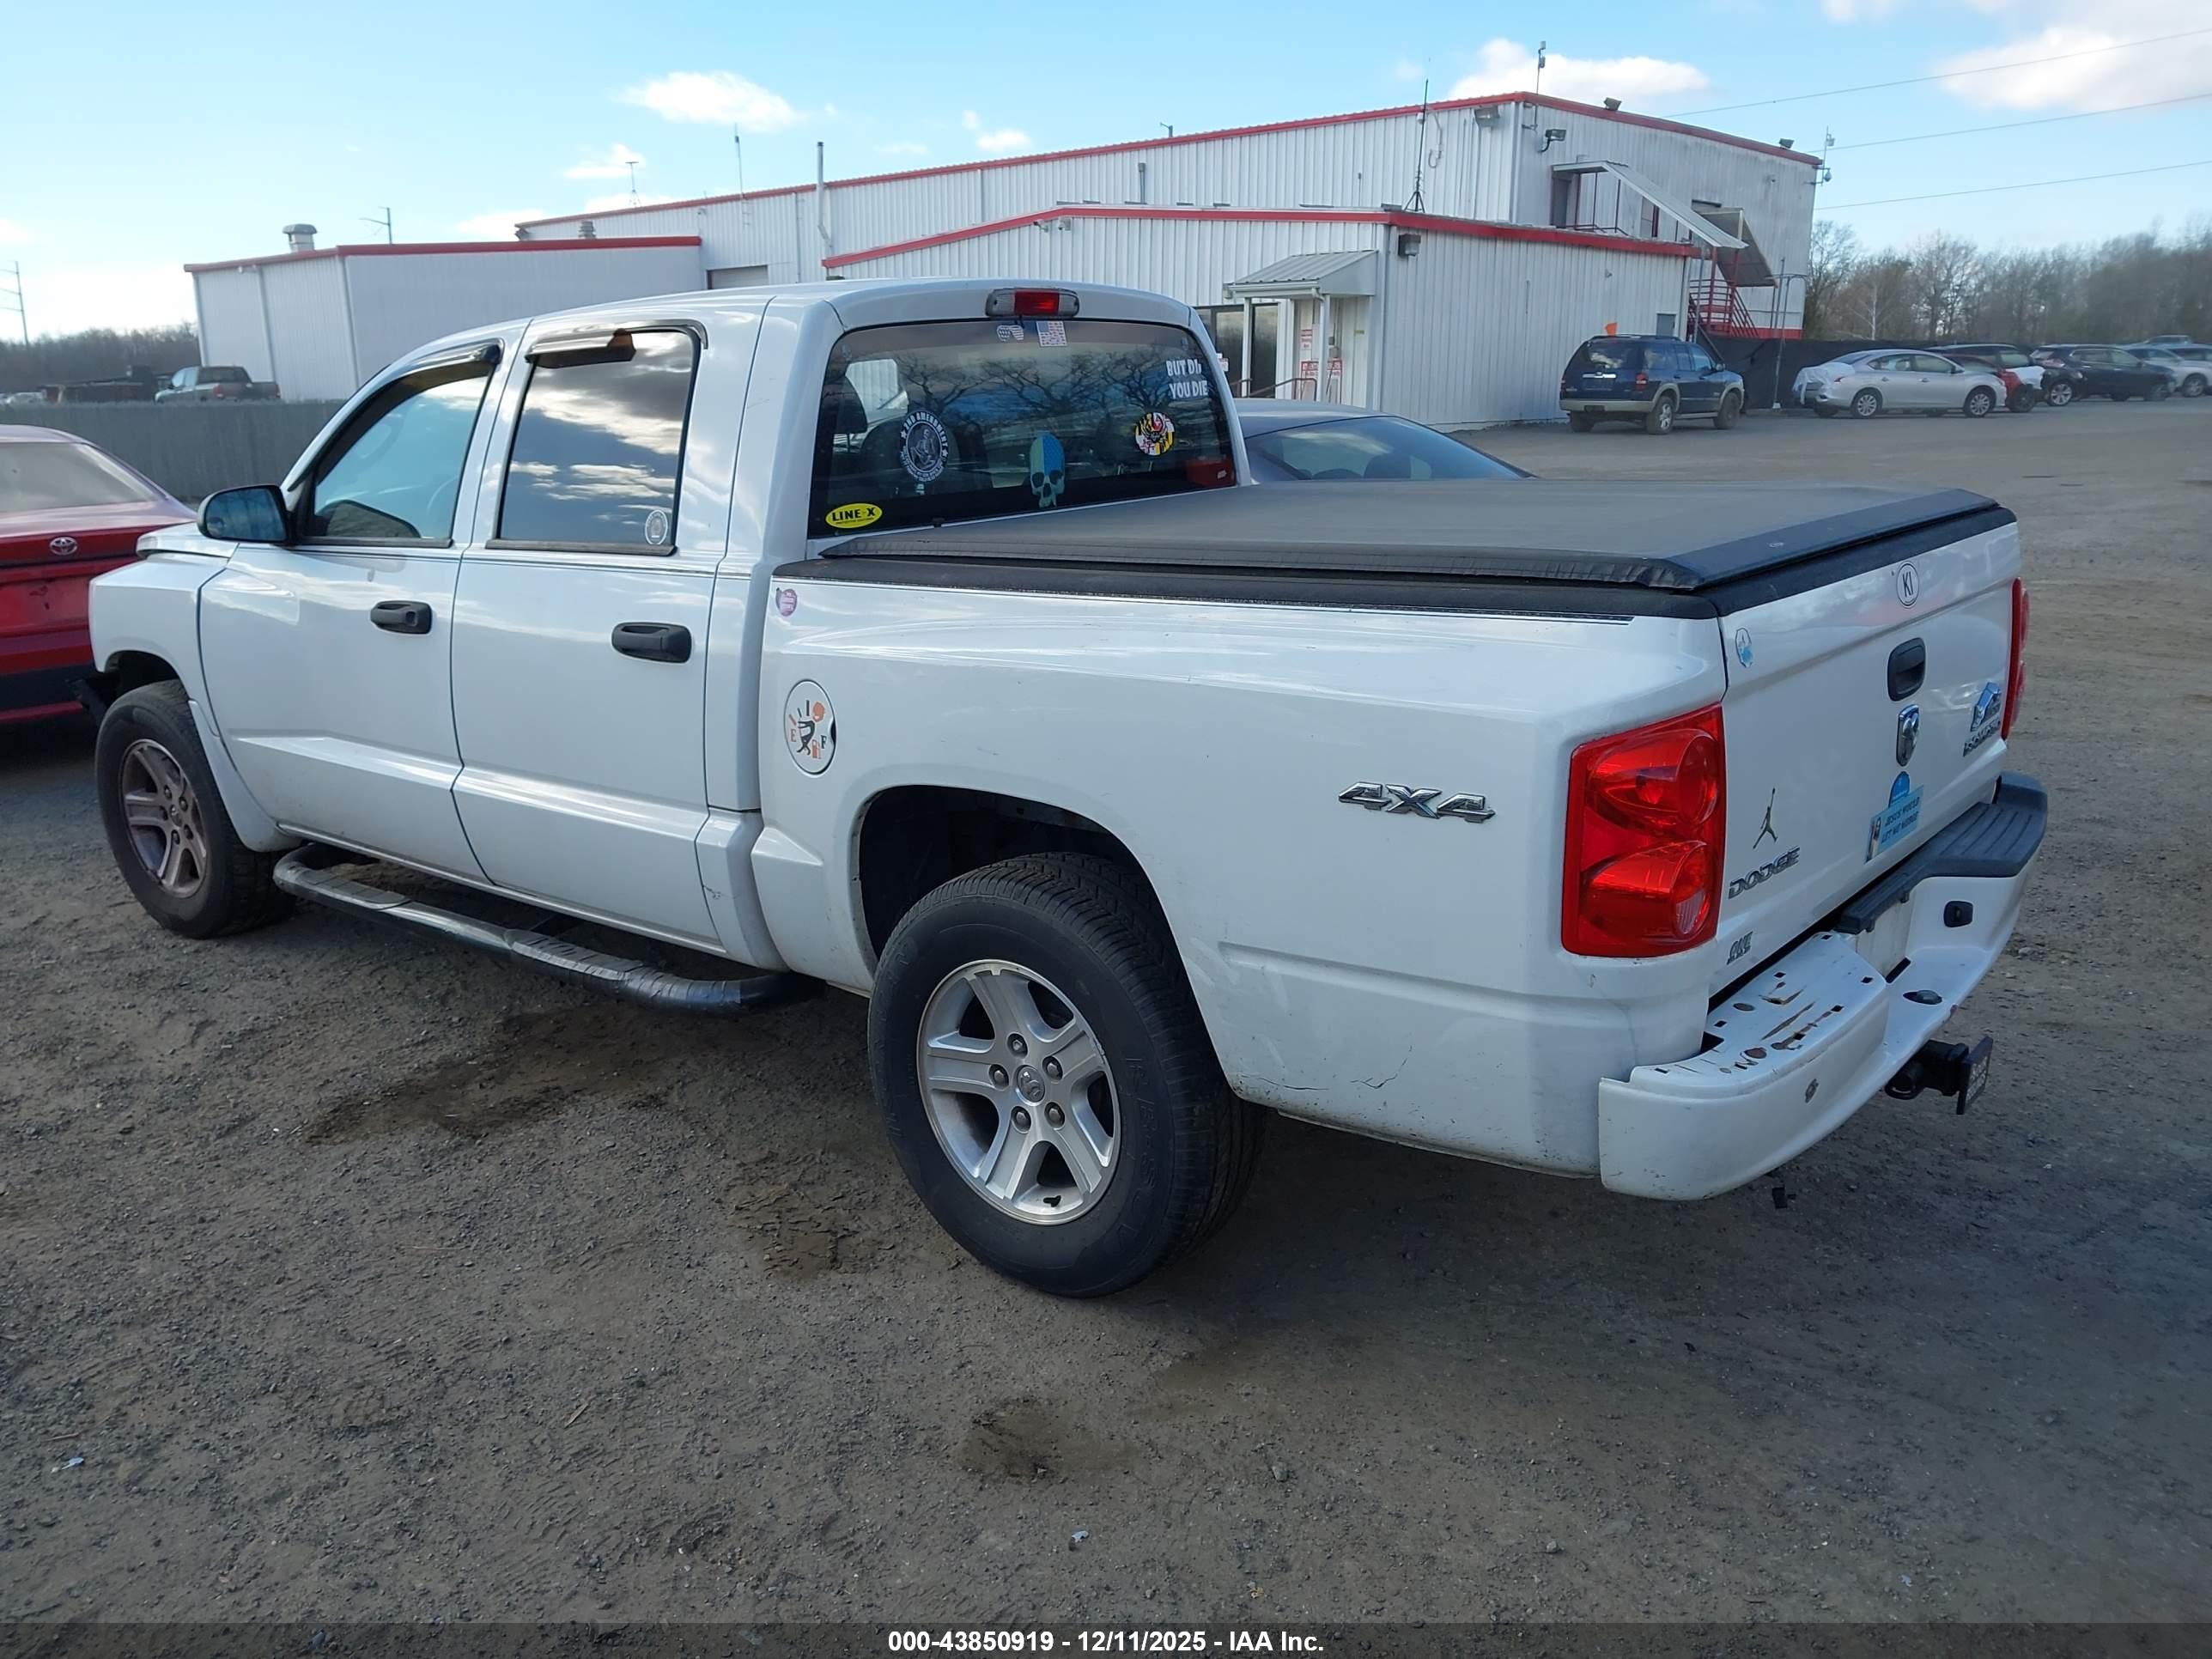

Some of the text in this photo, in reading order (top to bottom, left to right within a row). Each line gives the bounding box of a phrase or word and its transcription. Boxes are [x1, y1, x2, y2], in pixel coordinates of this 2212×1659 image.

[1166, 359, 1186, 376] BUT
[1169, 380, 1208, 399] YOU DIE
[790, 728, 797, 743] E
[821, 735, 827, 750] F
[1338, 781, 1496, 823] 4X4
[1728, 847, 1800, 900] DODGE
